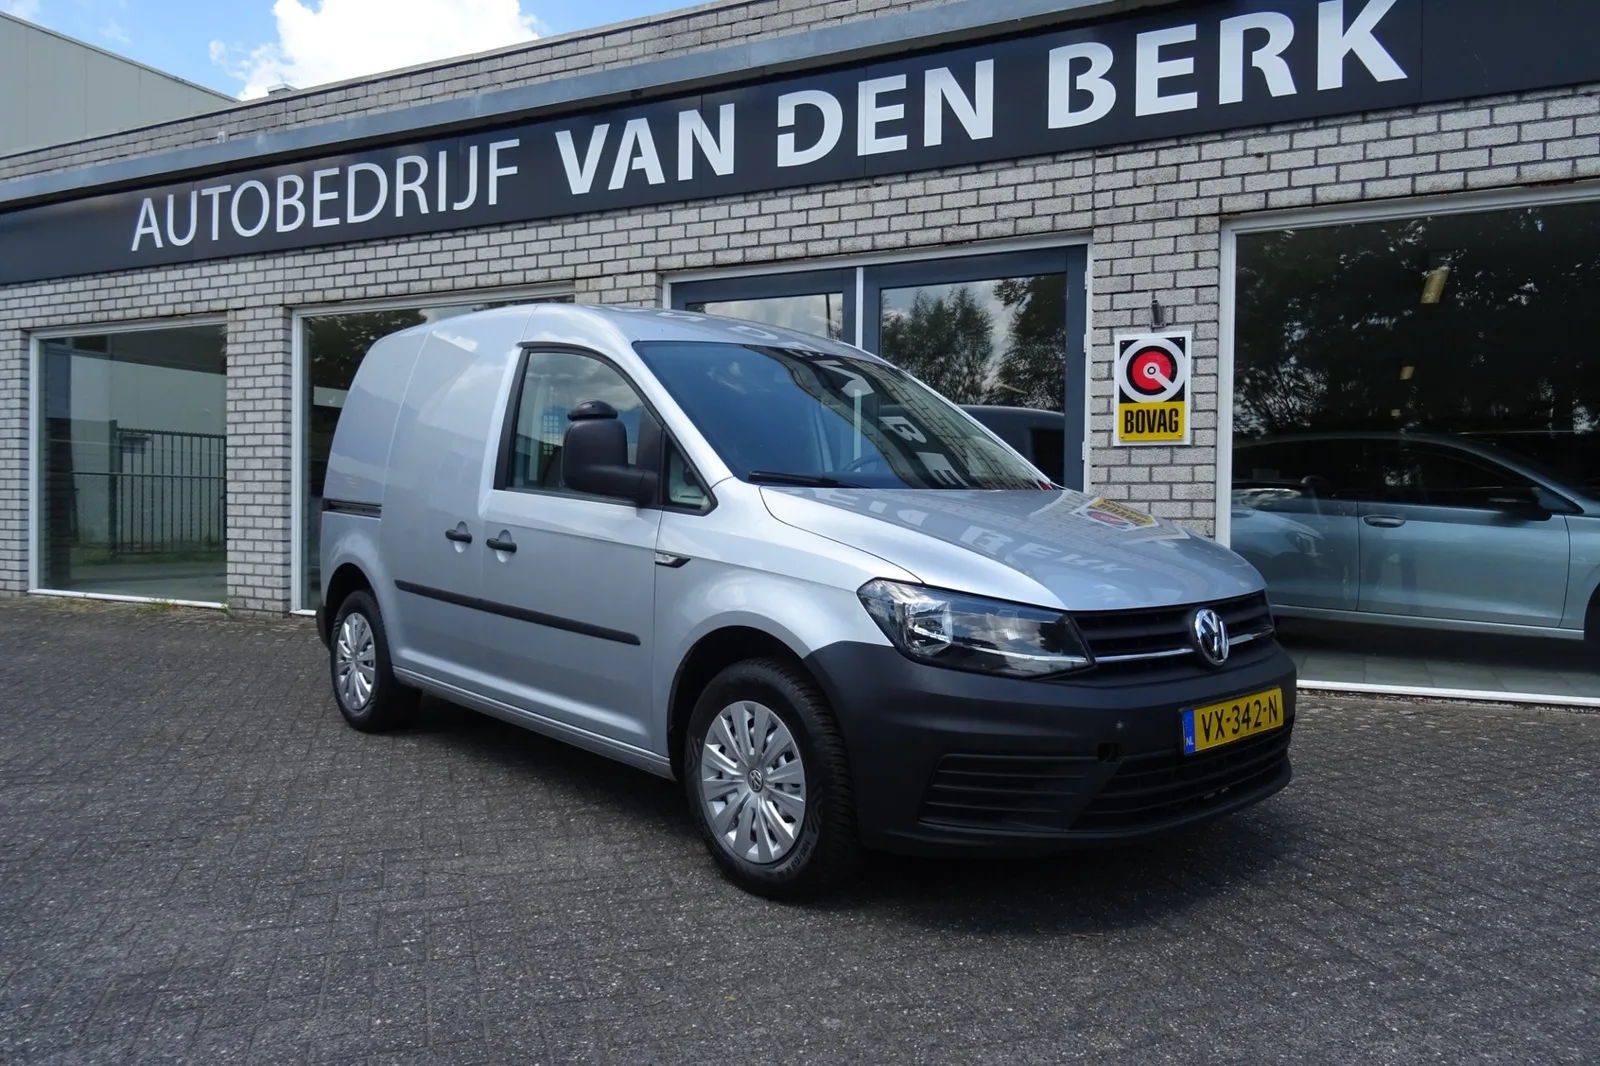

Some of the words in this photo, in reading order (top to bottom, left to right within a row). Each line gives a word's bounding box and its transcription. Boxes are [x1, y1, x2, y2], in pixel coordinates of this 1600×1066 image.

[131, 138, 521, 253] AUTOBEDRIJF
[555, 103, 735, 195] VAN
[776, 59, 994, 167] DEN
[1048, 0, 1408, 130] BERK
[1124, 408, 1179, 434] BOVAG
[1202, 695, 1278, 742] VX-342-N
